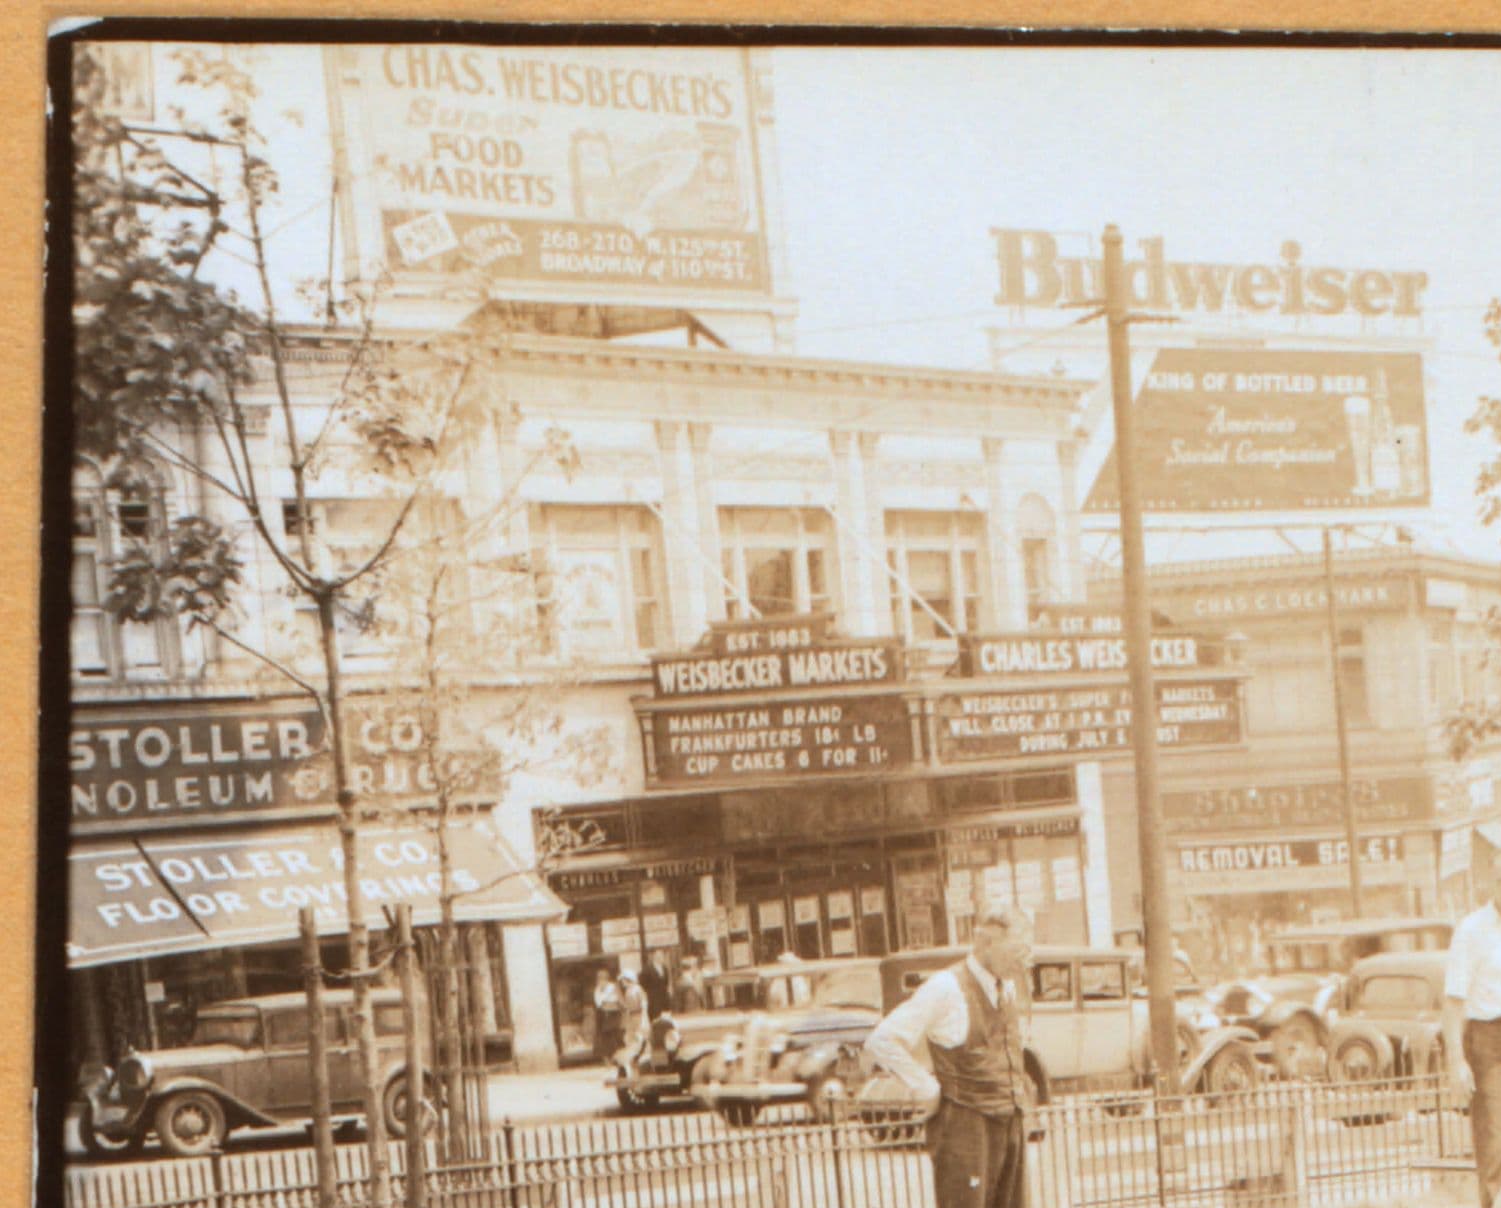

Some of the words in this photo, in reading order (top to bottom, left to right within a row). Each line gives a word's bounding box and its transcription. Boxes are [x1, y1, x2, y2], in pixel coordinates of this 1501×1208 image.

[381, 48, 495, 97] CHAS.
[498, 56, 735, 119] WEISBECKER'S
[429, 132, 524, 168] FOOD
[399, 162, 555, 207] MARKETS
[989, 225, 1429, 317] Budweiser
[1202, 371, 1229, 392] OF
[657, 654, 783, 694] WEISBECKER
[787, 647, 888, 686] MARKETS
[980, 639, 1073, 673] CHARLES
[1076, 636, 1198, 671] WEISCKER
[668, 709, 771, 734] MANHATTAN
[782, 704, 844, 727] BRAND
[991, 711, 1036, 733] CLOSE
[71, 720, 311, 770] STOLLER
[670, 726, 803, 754] FRANKFURTERS
[685, 755, 721, 776] CUP
[730, 750, 787, 772] CAKES
[821, 747, 858, 768] FOR
[72, 770, 274, 816] NOLEUM
[95, 848, 323, 892] STOLLER
[1180, 842, 1299, 873] REMOVAL
[1317, 836, 1398, 866] SAE!
[96, 888, 250, 928] FLOOR
